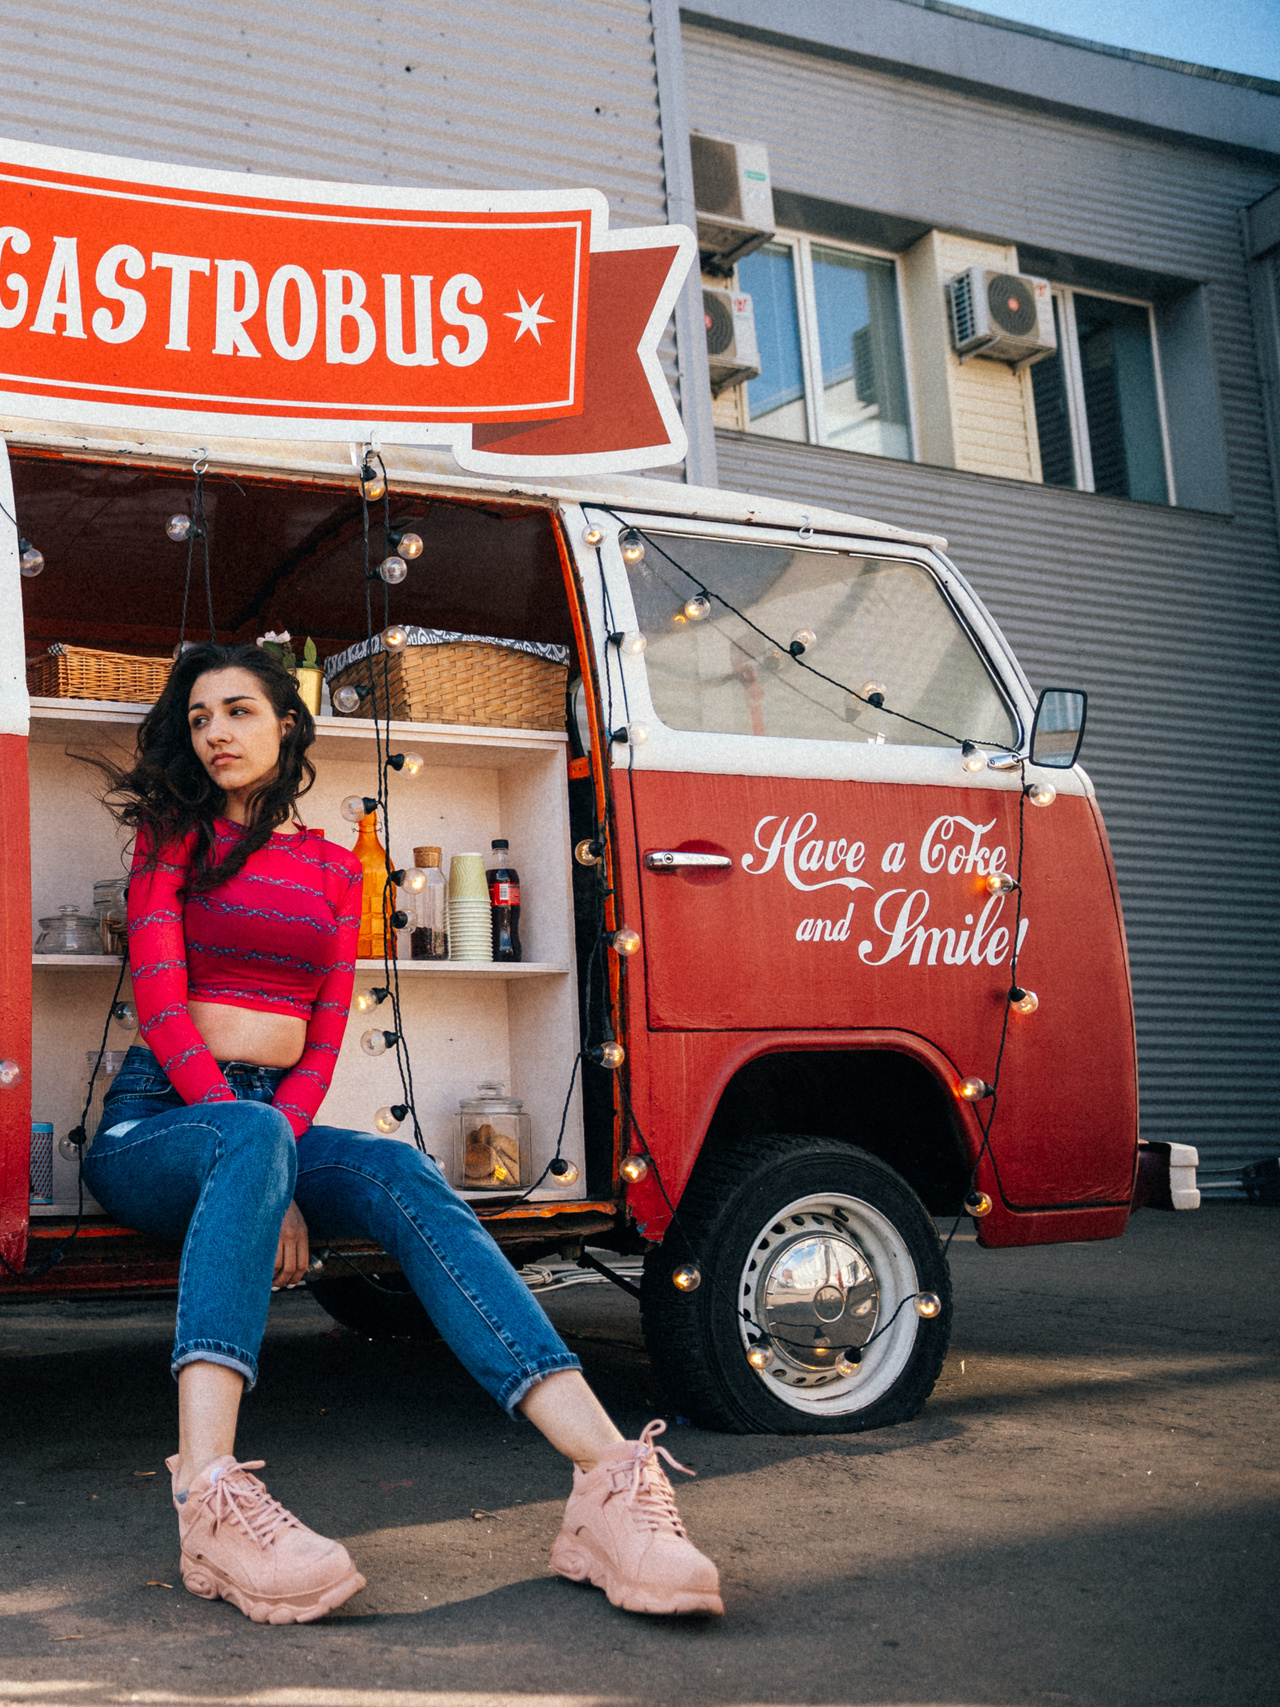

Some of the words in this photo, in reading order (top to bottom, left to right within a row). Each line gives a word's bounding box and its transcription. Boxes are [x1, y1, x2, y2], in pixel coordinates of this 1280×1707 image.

[741, 812, 875, 892] Have
[881, 842, 906, 874] a
[920, 815, 1007, 875] Coke
[795, 902, 855, 942] and
[858, 888, 1029, 966] Smile!
